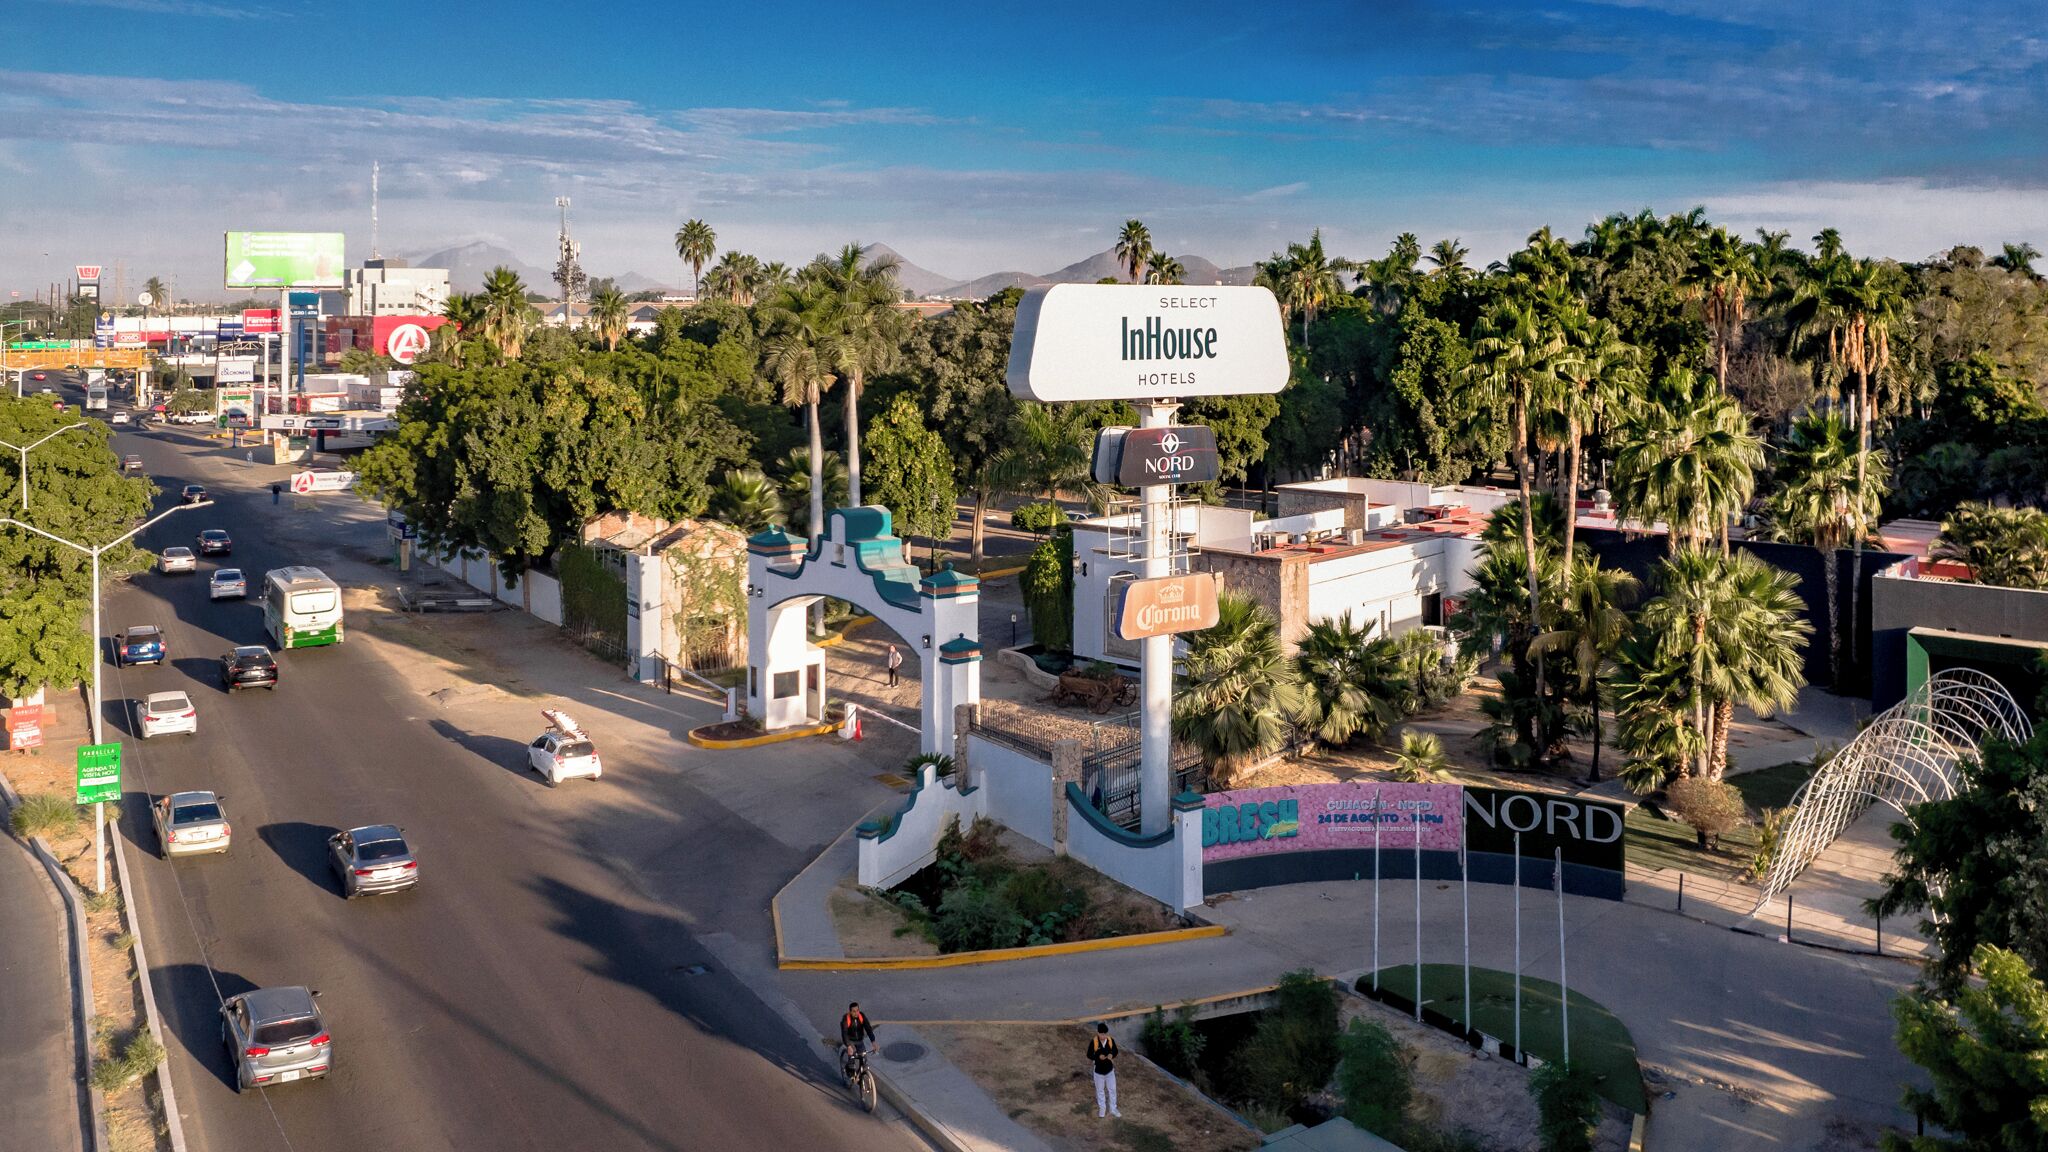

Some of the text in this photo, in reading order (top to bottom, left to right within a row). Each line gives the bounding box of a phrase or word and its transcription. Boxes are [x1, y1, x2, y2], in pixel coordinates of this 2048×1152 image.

[1160, 297, 1218, 309] SELECT
[1121, 316, 1218, 361] InHouse
[1138, 372, 1196, 386] HOTELS
[1145, 455, 1195, 474] NORD
[1136, 603, 1201, 632] Corona
[1398, 800, 1433, 811] NORD
[1201, 798, 1298, 848] BRESH
[1317, 813, 1331, 824] 24
[1333, 813, 1348, 823] DE
[1463, 790, 1623, 843] NORD
